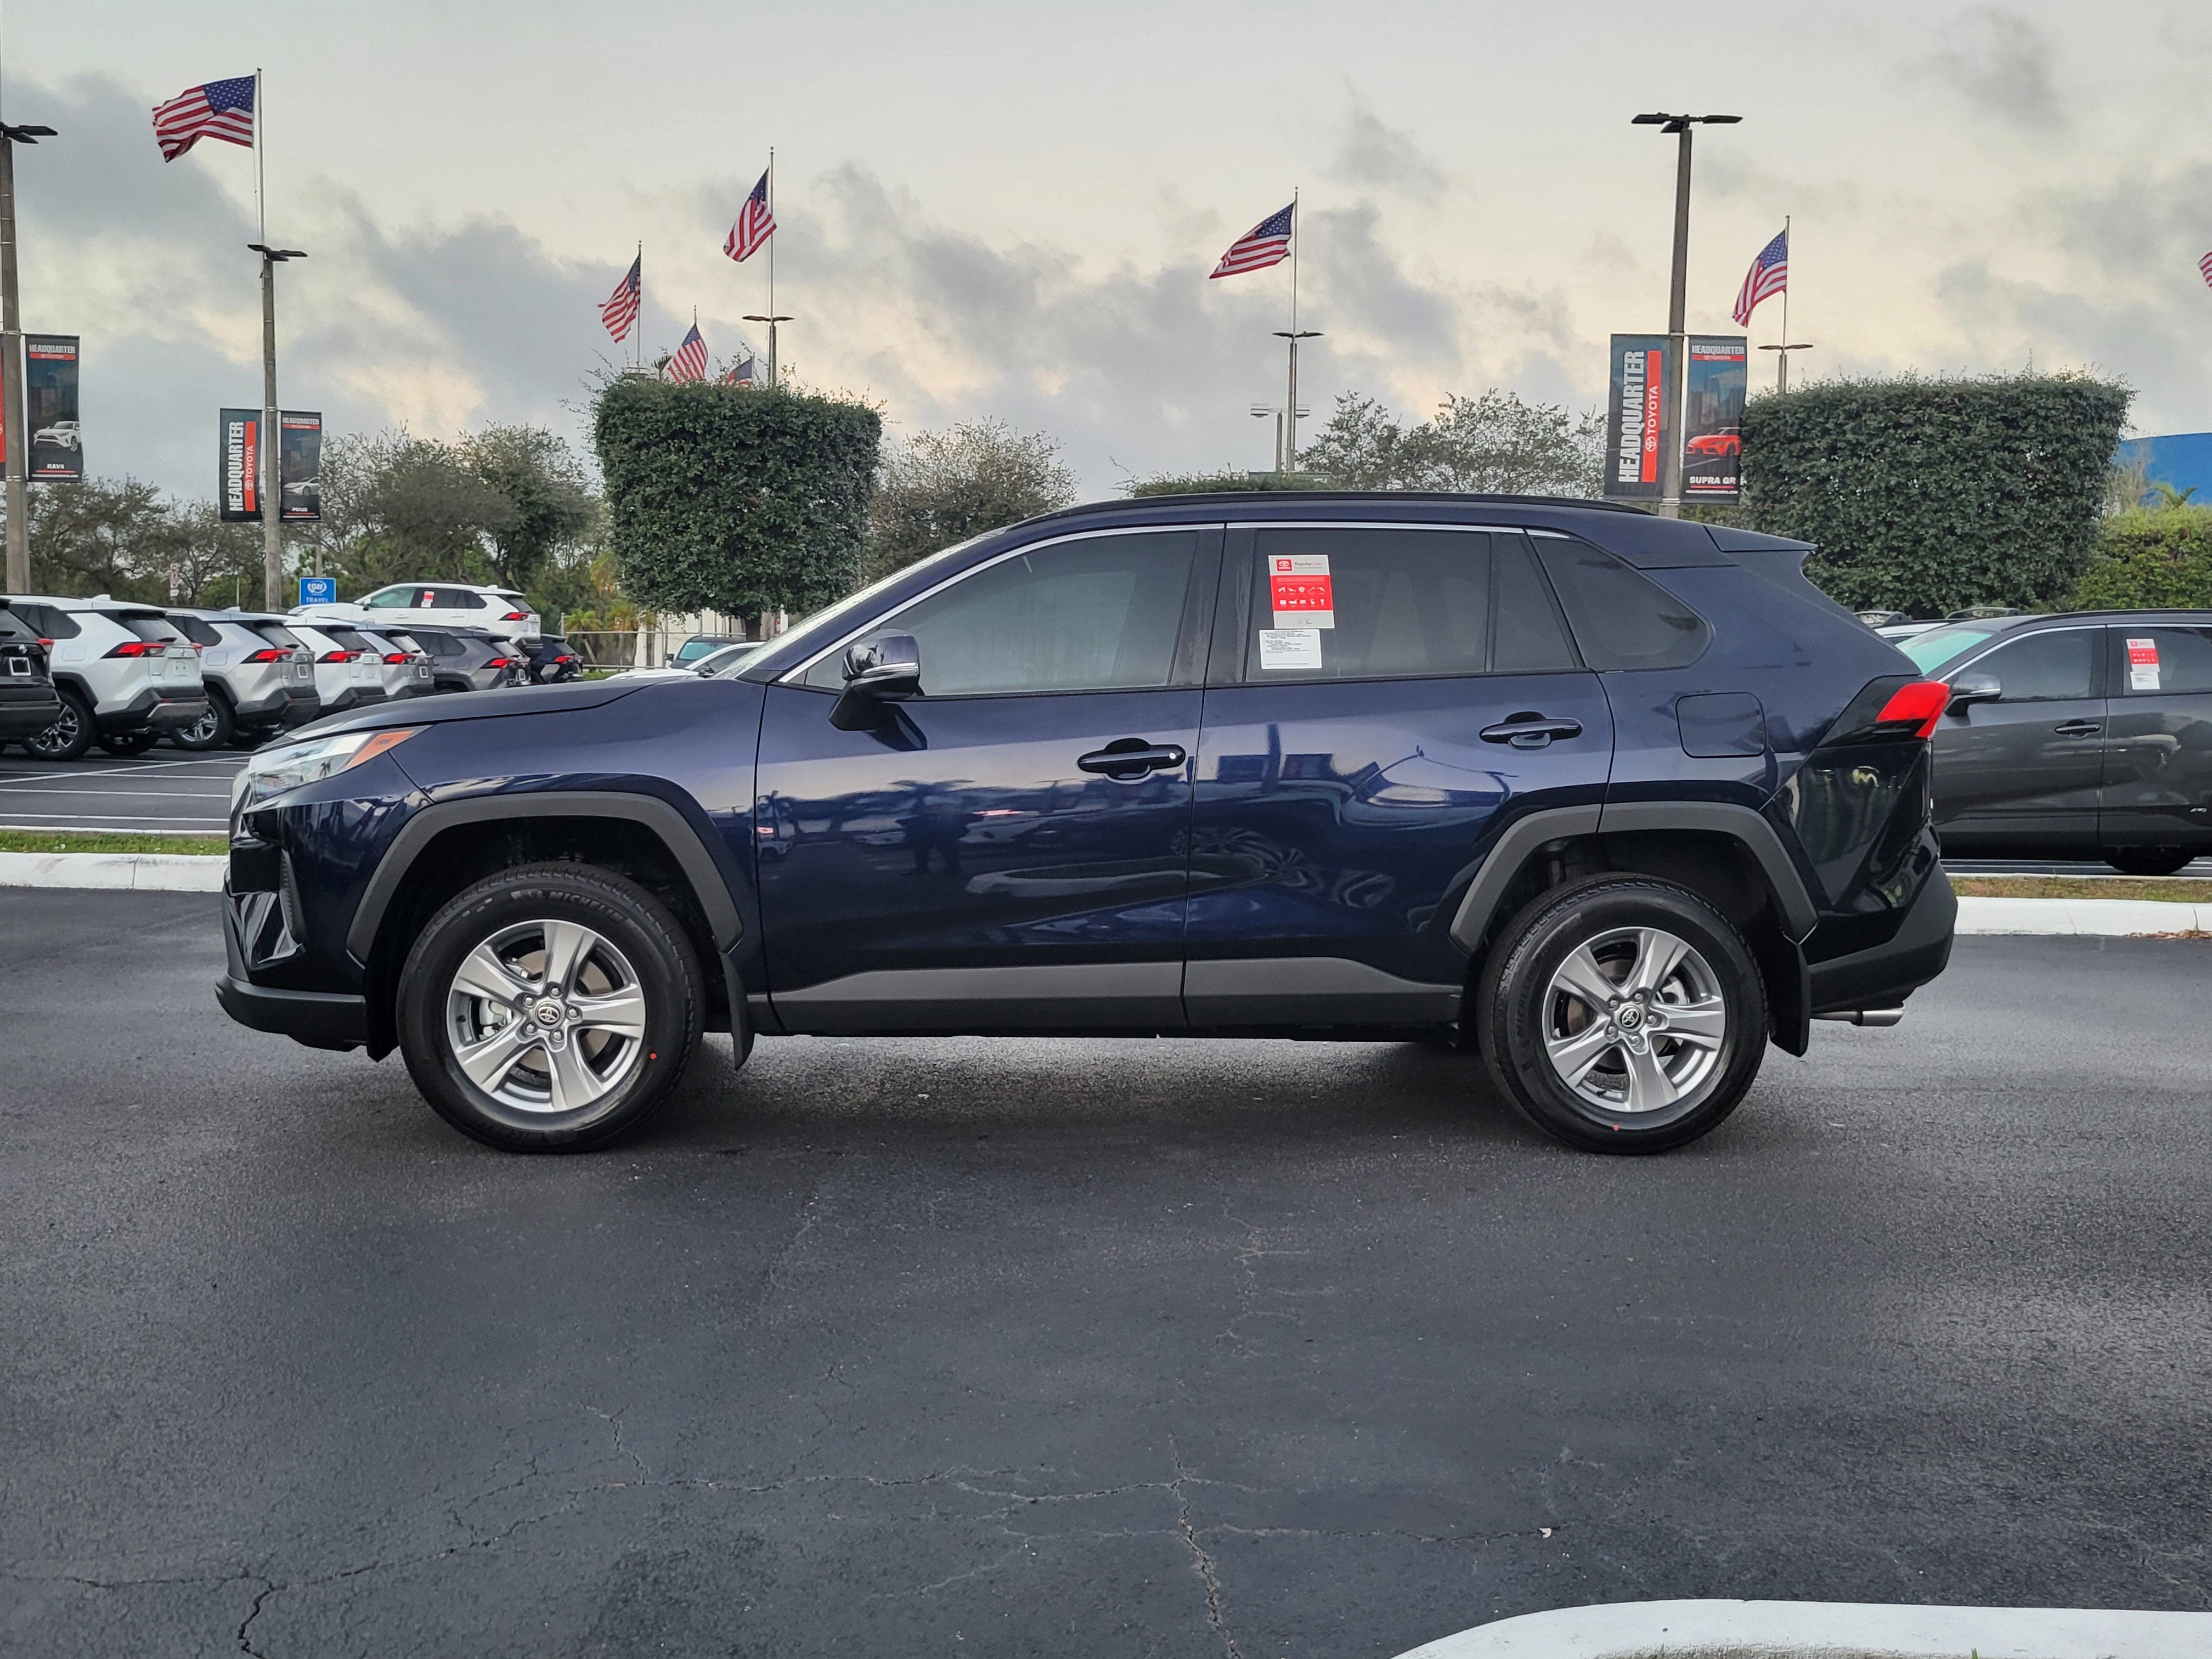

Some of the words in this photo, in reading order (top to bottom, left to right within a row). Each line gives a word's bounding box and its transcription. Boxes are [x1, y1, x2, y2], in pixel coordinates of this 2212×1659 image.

[29, 344, 76, 354] HEADQUARTER
[1691, 345, 1745, 355] HEADQUARTER
[1618, 351, 1645, 483] HEADQUARTER
[1647, 386, 1658, 435] TOYOTA
[228, 421, 244, 511] HEADQUARTER
[246, 445, 254, 478] TOYOTA
[1689, 476, 1721, 484] SUPRA
[549, 891, 623, 920] MICHELIN
